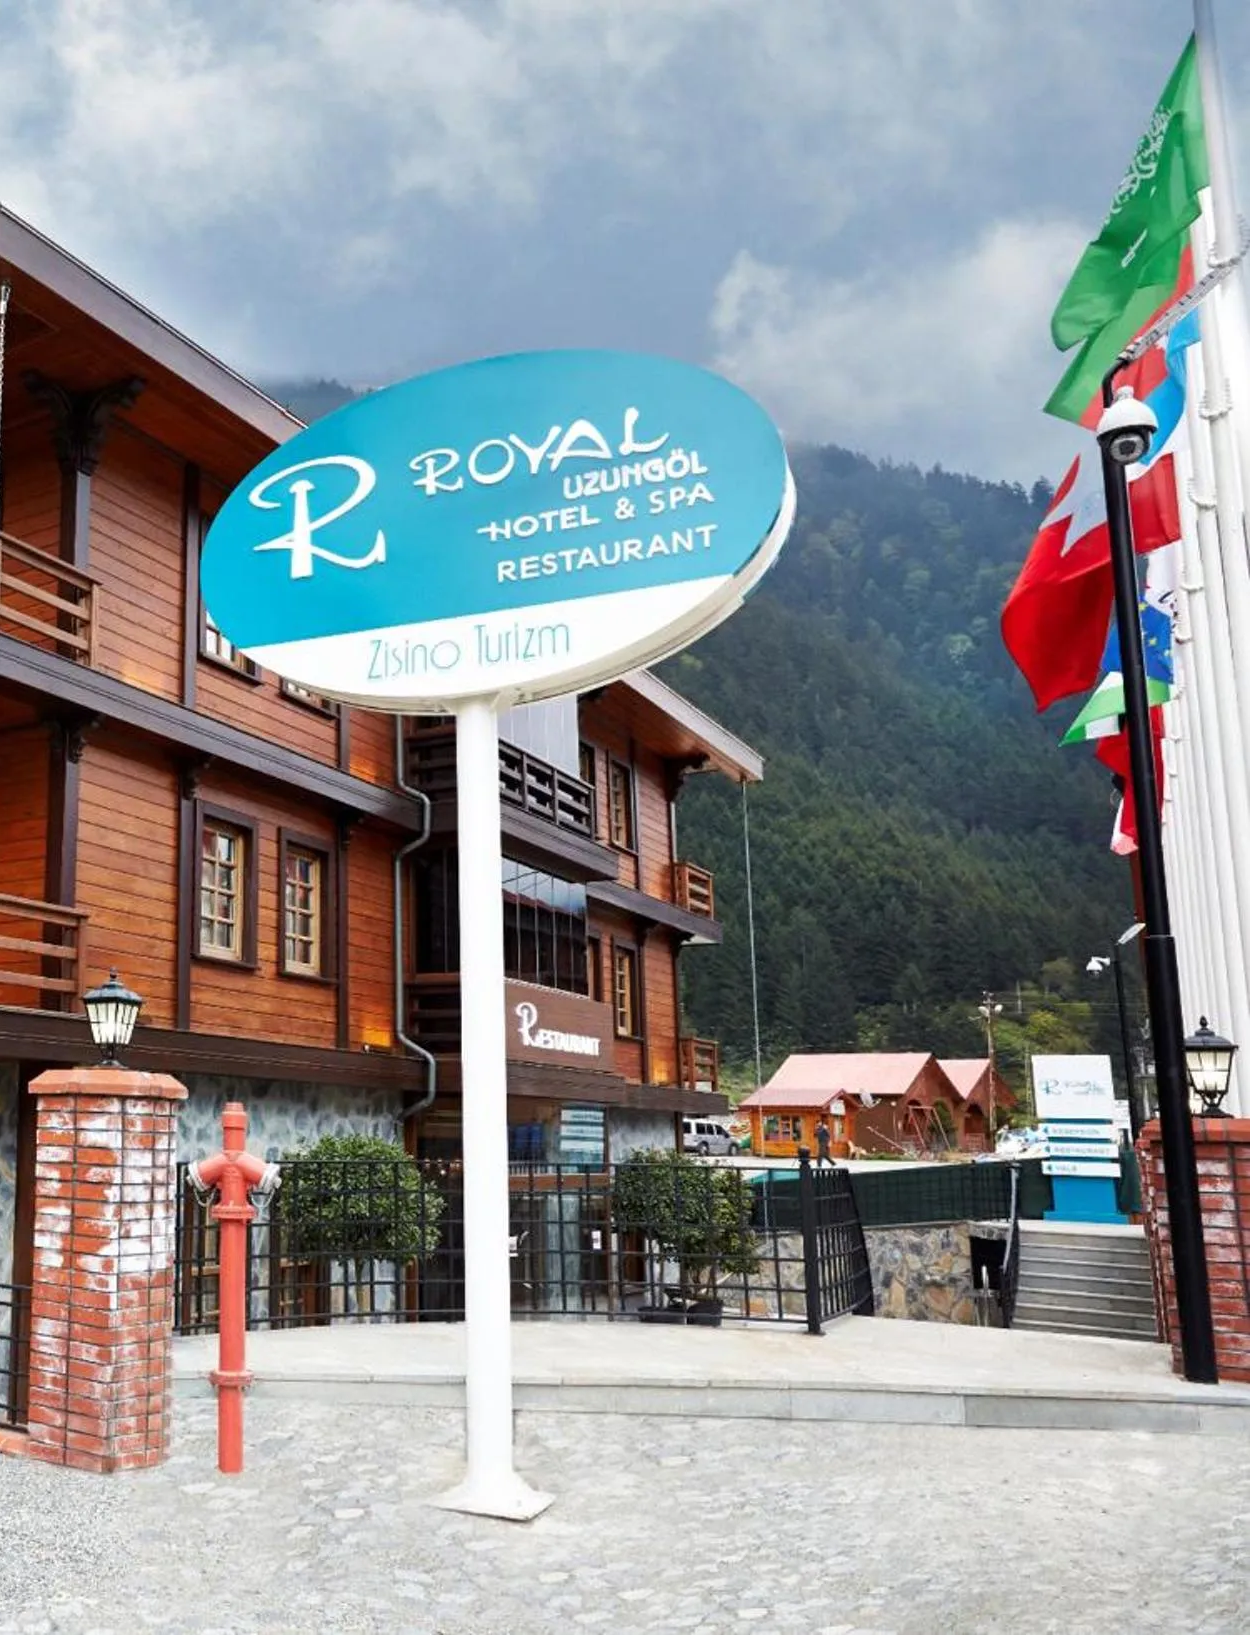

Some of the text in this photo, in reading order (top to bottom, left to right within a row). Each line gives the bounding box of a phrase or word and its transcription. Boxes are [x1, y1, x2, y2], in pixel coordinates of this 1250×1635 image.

[409, 406, 670, 496] ROYAL
[562, 447, 709, 500] UZUNGÖL
[249, 455, 386, 578] R
[476, 482, 716, 542] HOTEL & SPA
[496, 523, 719, 583] RESTAURANT
[366, 621, 570, 680] Zisino Turizm
